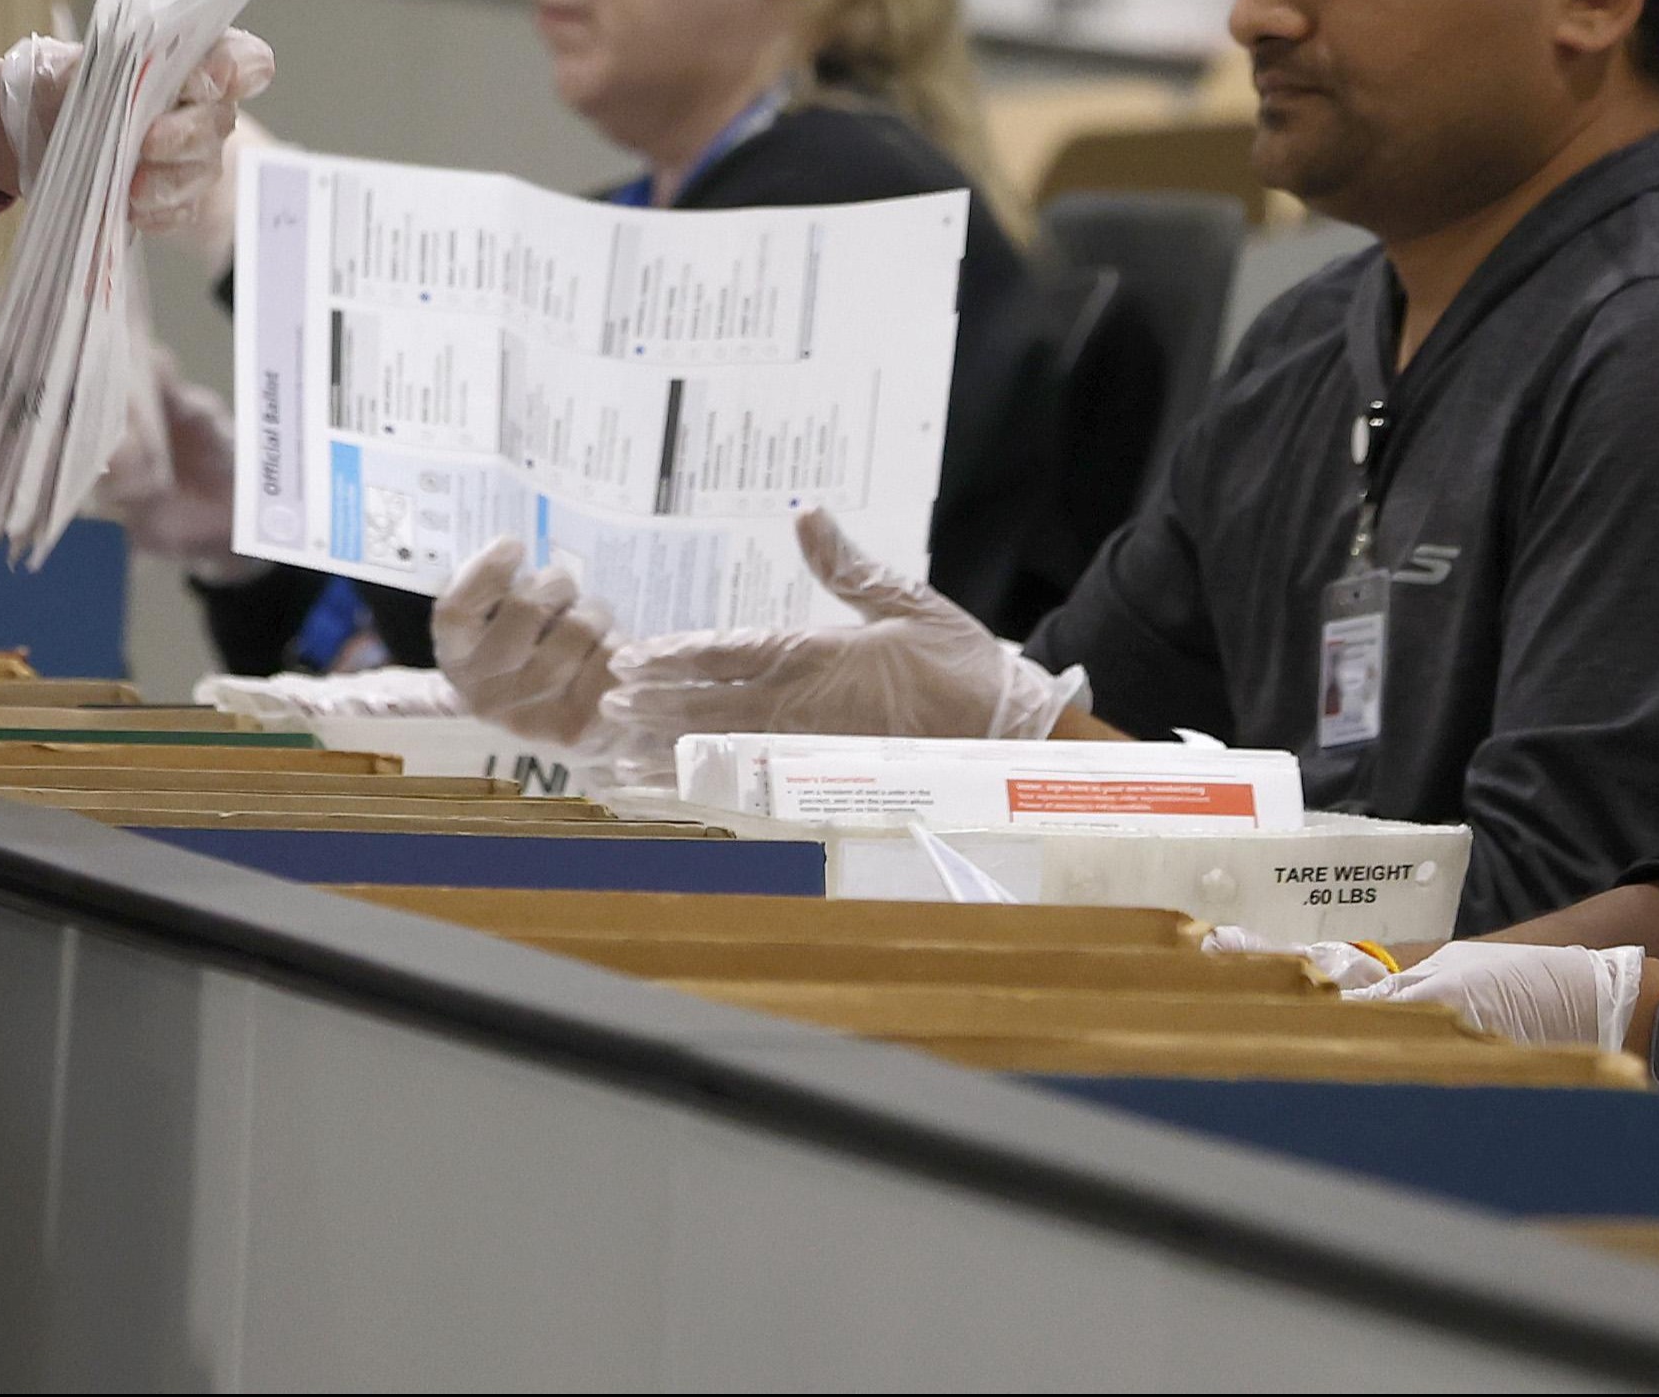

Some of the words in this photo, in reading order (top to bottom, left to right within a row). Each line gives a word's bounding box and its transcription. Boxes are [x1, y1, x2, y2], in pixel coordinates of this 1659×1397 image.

[262, 426, 281, 495] Official
[1274, 867, 1328, 883] TARE
[1334, 864, 1413, 882] WEIGHT
[1303, 889, 1332, 905] .60
[1338, 888, 1377, 904] LBS
